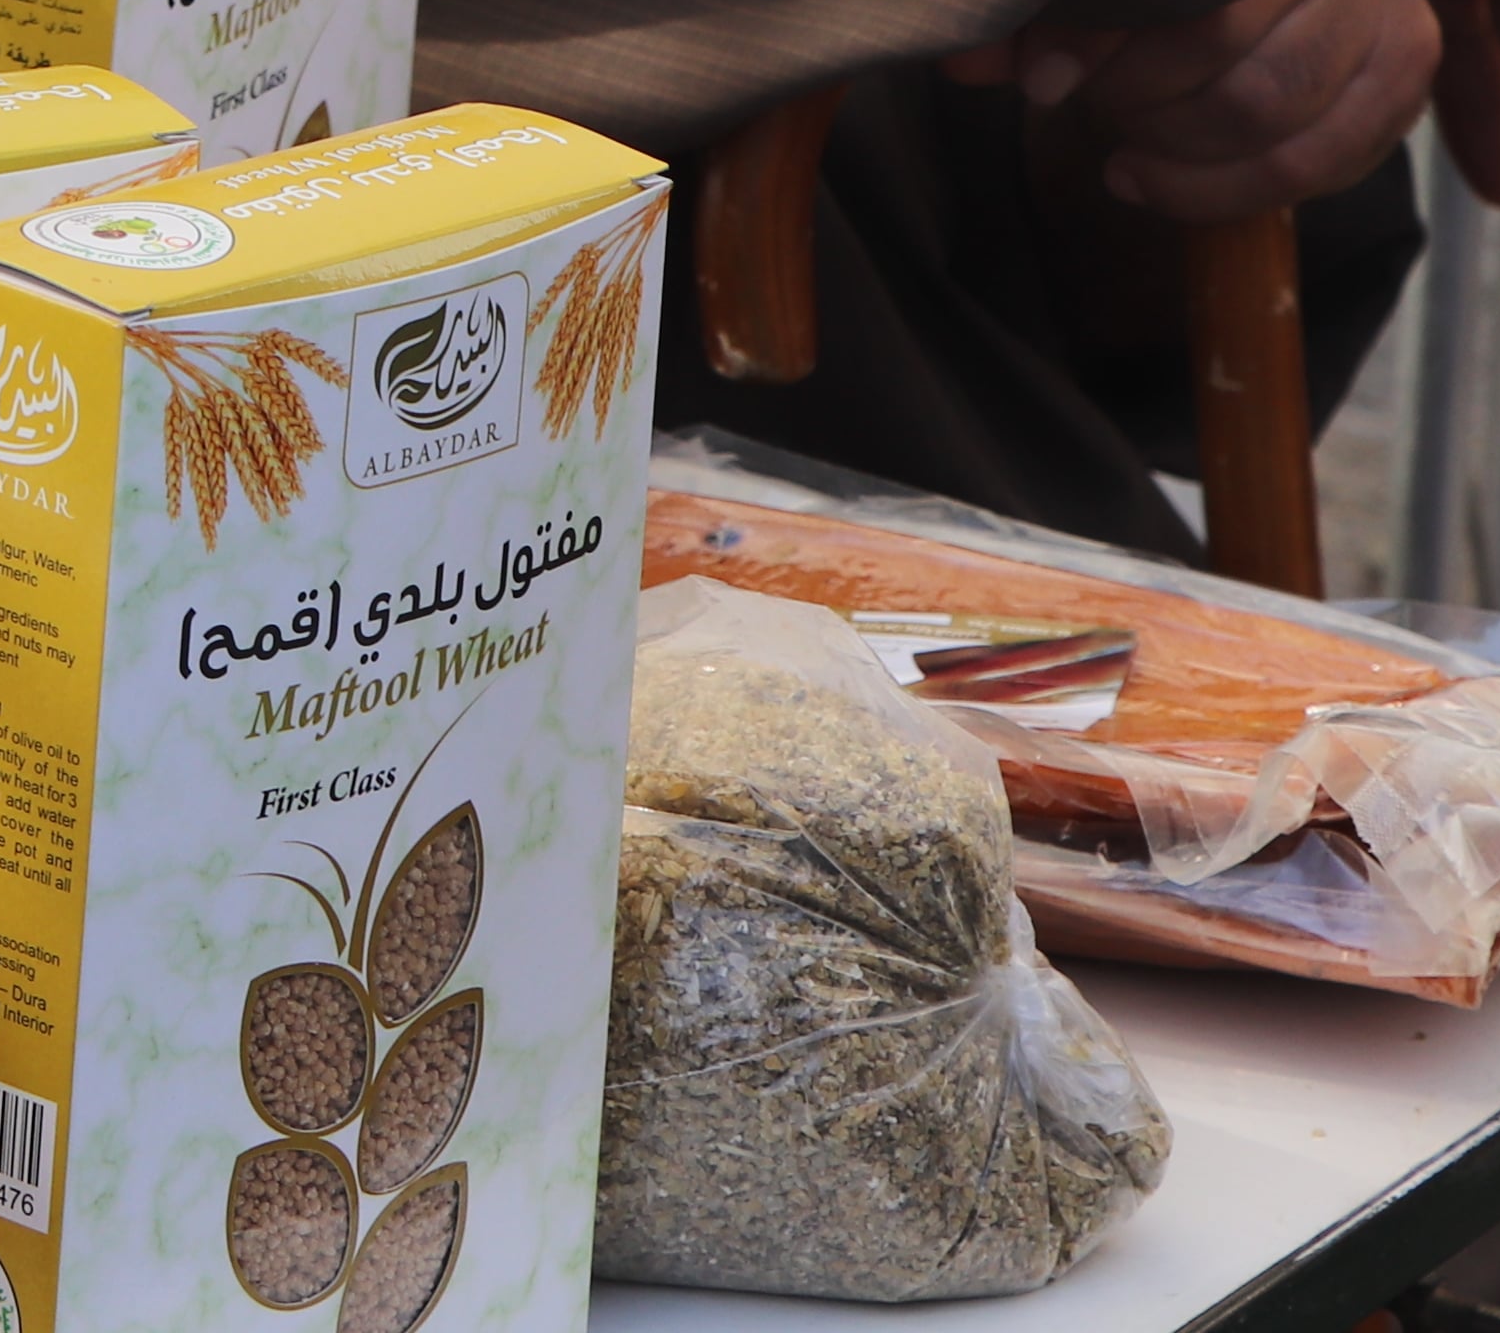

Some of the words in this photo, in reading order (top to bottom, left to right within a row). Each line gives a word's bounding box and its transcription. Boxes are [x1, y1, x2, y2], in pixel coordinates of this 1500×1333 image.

[210, 87, 246, 121] First
[250, 66, 288, 100] Class
[323, 125, 461, 162] Maftool
[214, 155, 334, 189] Wheat
[221, 175, 344, 219] مفتول
[341, 149, 433, 186] بلدي
[434, 126, 569, 168] (قمح)
[363, 422, 501, 478] ALBAYDAR
[33, 550, 76, 581] Water,
[474, 510, 603, 611] مفتول
[178, 580, 342, 680] (قمح)
[353, 562, 467, 665] بلدي
[14, 637, 42, 653] nuts
[47, 645, 75, 668] may
[244, 647, 425, 741] Maftool
[437, 610, 552, 691] Wheat
[12, 732, 43, 753] olive
[47, 745, 62, 760] oil
[66, 750, 80, 766] to
[14, 775, 44, 797] heat
[47, 785, 66, 803] for
[68, 793, 77, 808] 3
[34, 761, 49, 777] of
[56, 767, 79, 787] the
[257, 783, 322, 820] First
[329, 765, 398, 803] Class
[6, 794, 31, 814] add
[38, 803, 76, 829] water
[0, 814, 42, 838] cover
[51, 830, 74, 850] the
[14, 841, 37, 861] pot
[46, 853, 72, 871] and
[23, 863, 52, 886] until
[55, 877, 71, 893] all
[12, 985, 47, 1011] Dura
[3, 1005, 55, 1036] Interior
